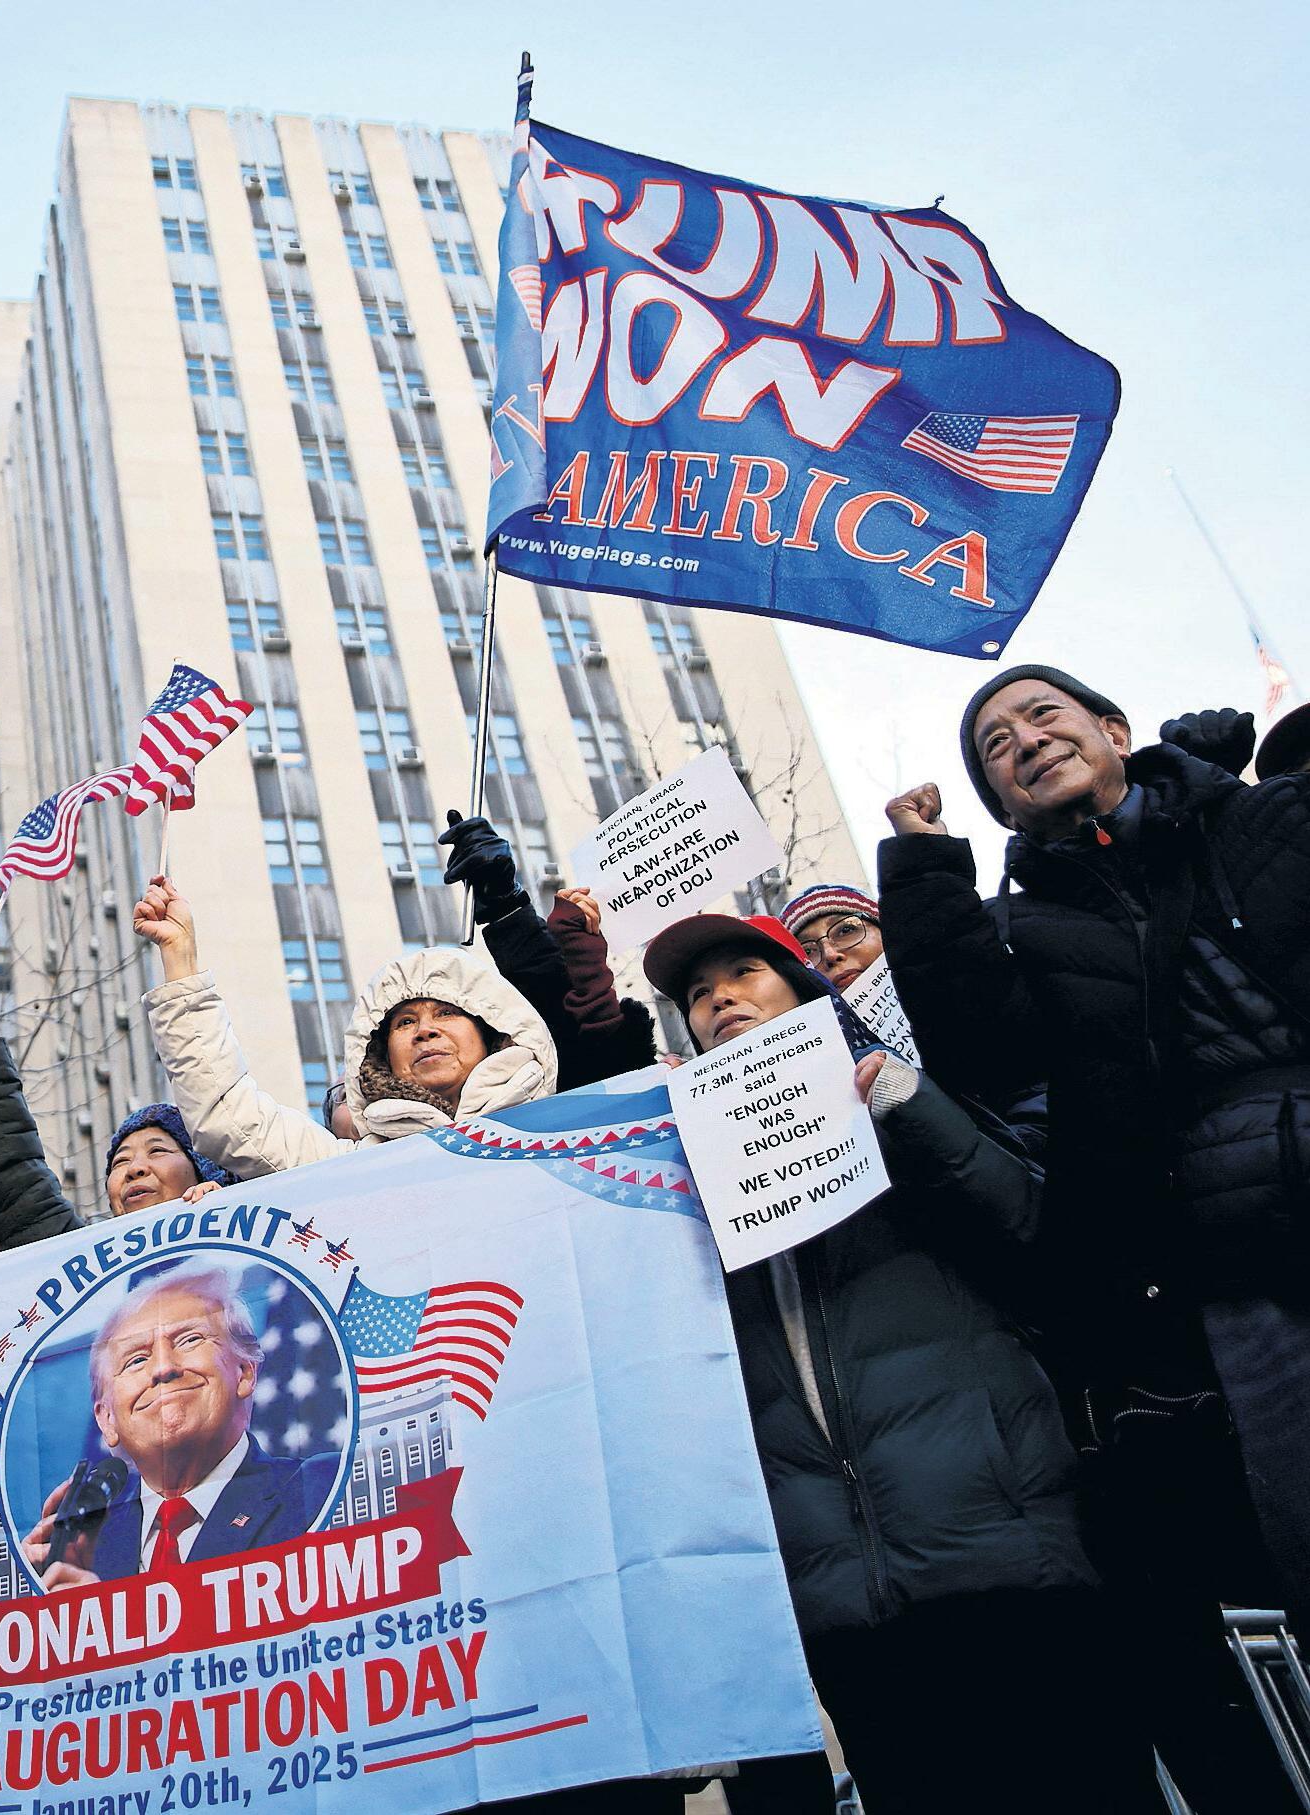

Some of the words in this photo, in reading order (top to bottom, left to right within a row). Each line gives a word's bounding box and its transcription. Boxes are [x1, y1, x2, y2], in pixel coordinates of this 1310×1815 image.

[528, 136, 1008, 347] RUMP
[532, 450, 995, 606] AMERICA
[595, 805, 643, 842] MERCHAN
[649, 778, 684, 805] BRAGG
[599, 799, 707, 872] PERSECUTION
[607, 797, 686, 850] POLITICAL
[607, 829, 740, 913] WEAPONIZATION
[622, 828, 706, 883] LAW-FARE
[656, 887, 677, 908] OF
[681, 867, 713, 895] DOJ
[690, 1073, 738, 1099] 77.3M.
[743, 1036, 823, 1077] Americans
[693, 1045, 753, 1079] MERCHAN
[763, 1022, 807, 1047] BREGG
[744, 1071, 777, 1093] said
[725, 1082, 809, 1121] "ENOUGH
[759, 1108, 795, 1130] WAS
[739, 1172, 772, 1195] WE
[774, 1137, 856, 1182] VOTED!!!
[743, 1115, 826, 1157] ENOUGH"
[729, 1195, 802, 1233] TRUMP
[806, 1156, 870, 1203] WON!!!
[35, 1204, 291, 1317] PRESIDENT
[201, 1526, 422, 1634] TRUMP
[153, 1657, 184, 1698] of
[190, 1652, 248, 1691] the
[256, 1620, 365, 1679] United
[374, 1597, 488, 1650] States
[364, 1630, 488, 1727] DAY
[161, 1766, 252, 1814] 20th,
[267, 1741, 358, 1796] 2025
